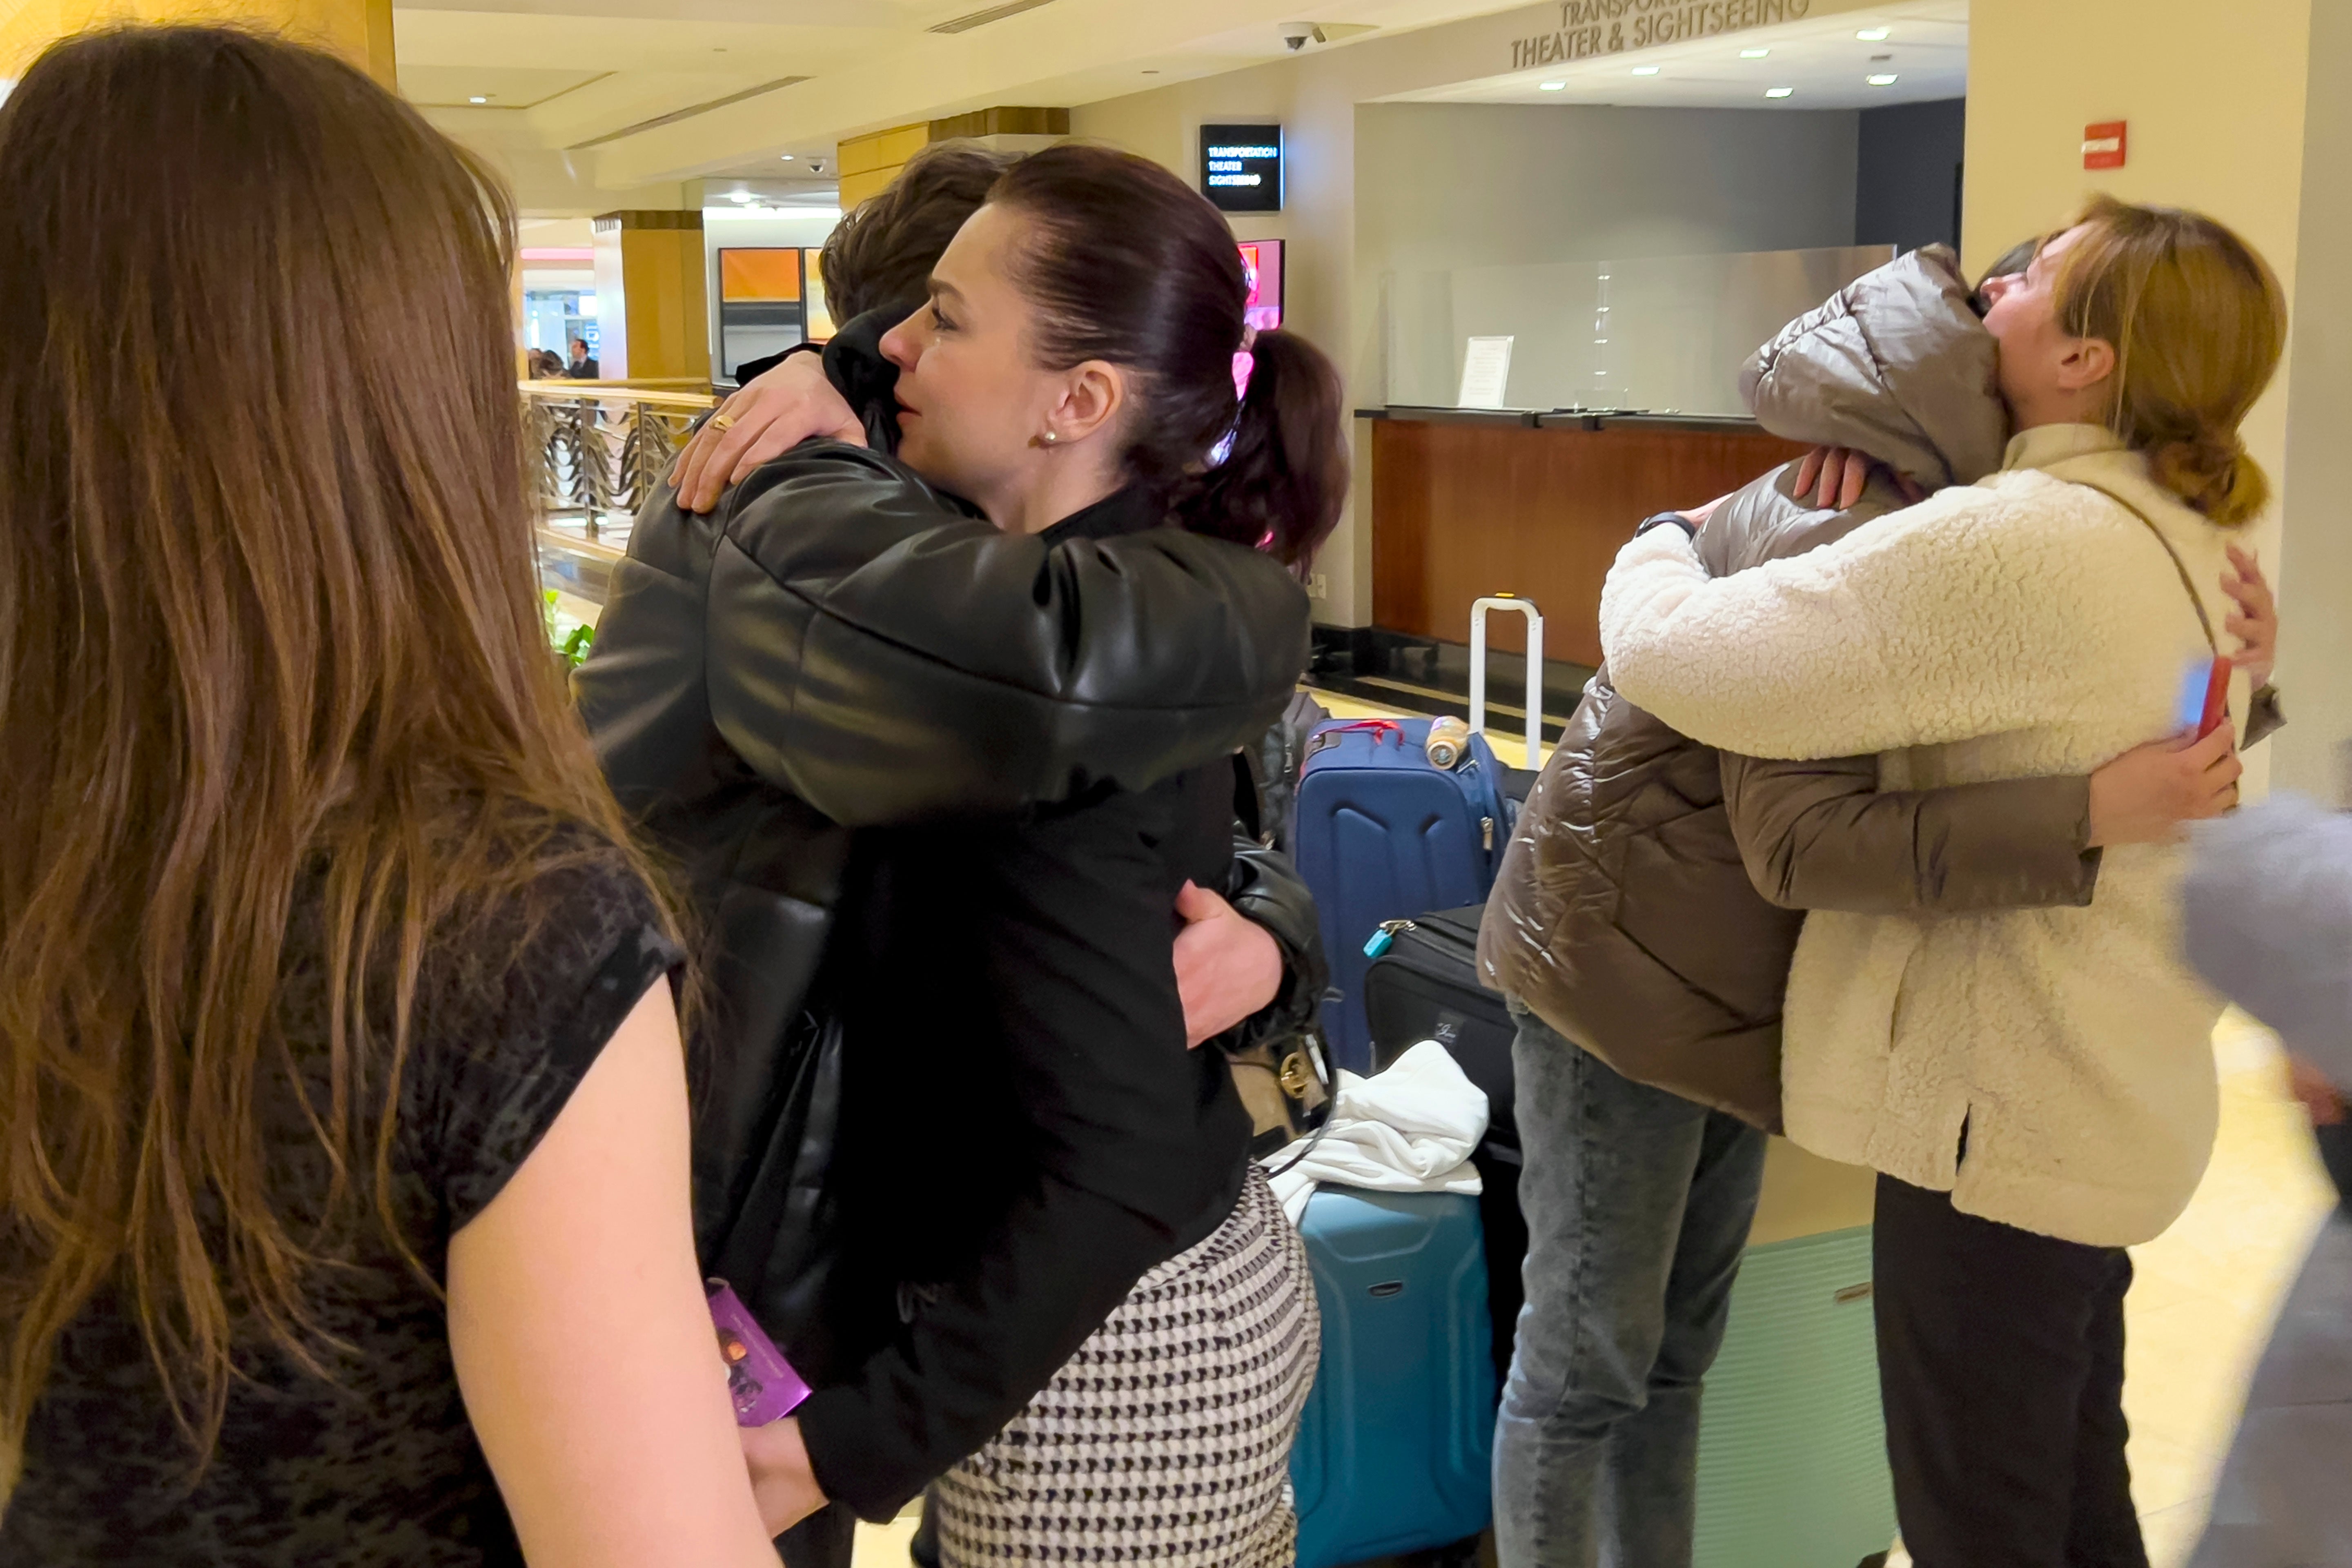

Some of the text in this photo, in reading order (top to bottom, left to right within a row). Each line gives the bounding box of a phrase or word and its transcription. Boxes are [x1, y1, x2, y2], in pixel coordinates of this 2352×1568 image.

[1511, 0, 1809, 69] THEATER & SIGHTSEEING
